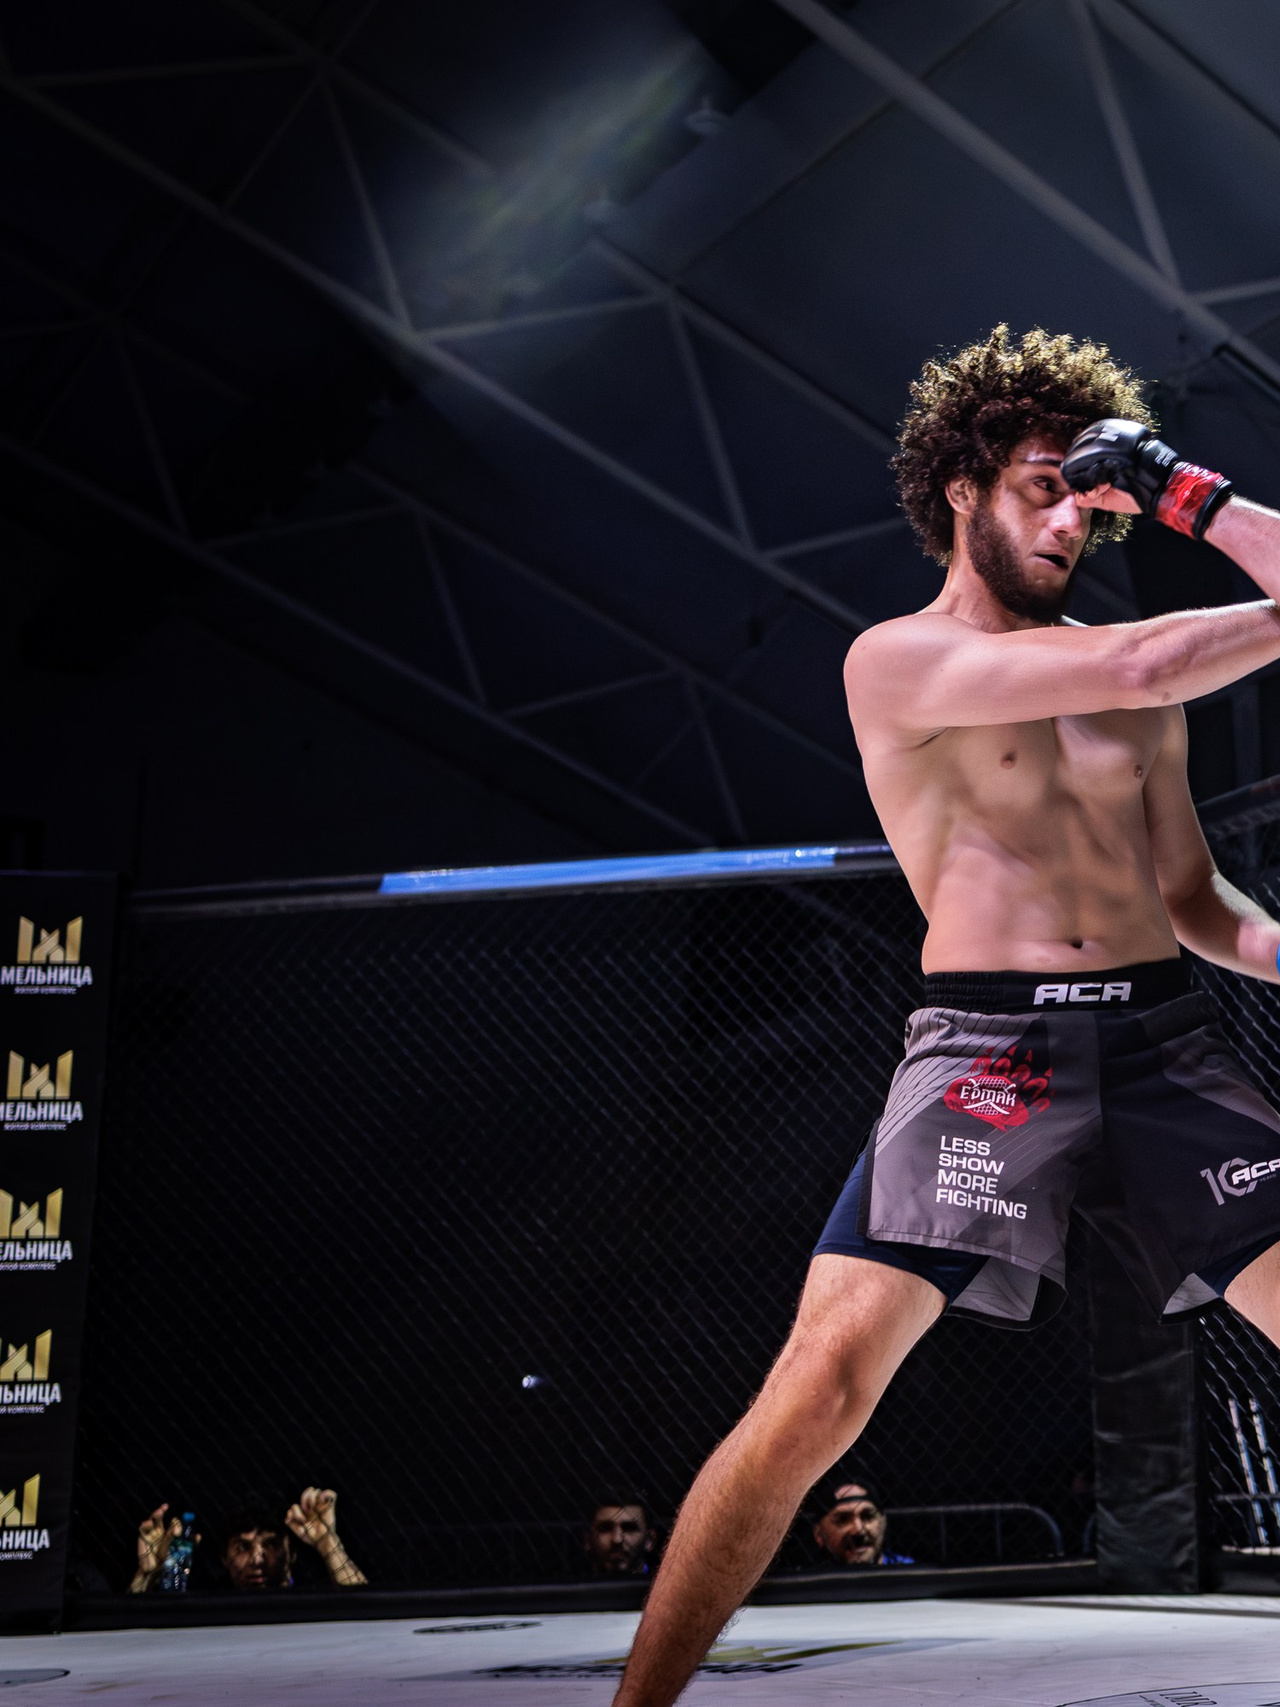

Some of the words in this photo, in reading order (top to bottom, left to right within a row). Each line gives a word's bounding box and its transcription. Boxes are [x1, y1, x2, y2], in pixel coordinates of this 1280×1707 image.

[1, 965, 93, 988] МЕЛЬНИЦА
[940, 1135, 991, 1156] LESS
[938, 1153, 1005, 1175] SHOW
[937, 1169, 999, 1195] MORE
[935, 1188, 1028, 1220] FIGHTING
[0, 1382, 62, 1406] ЬНИЦА
[0, 1529, 51, 1552] НИЦА
